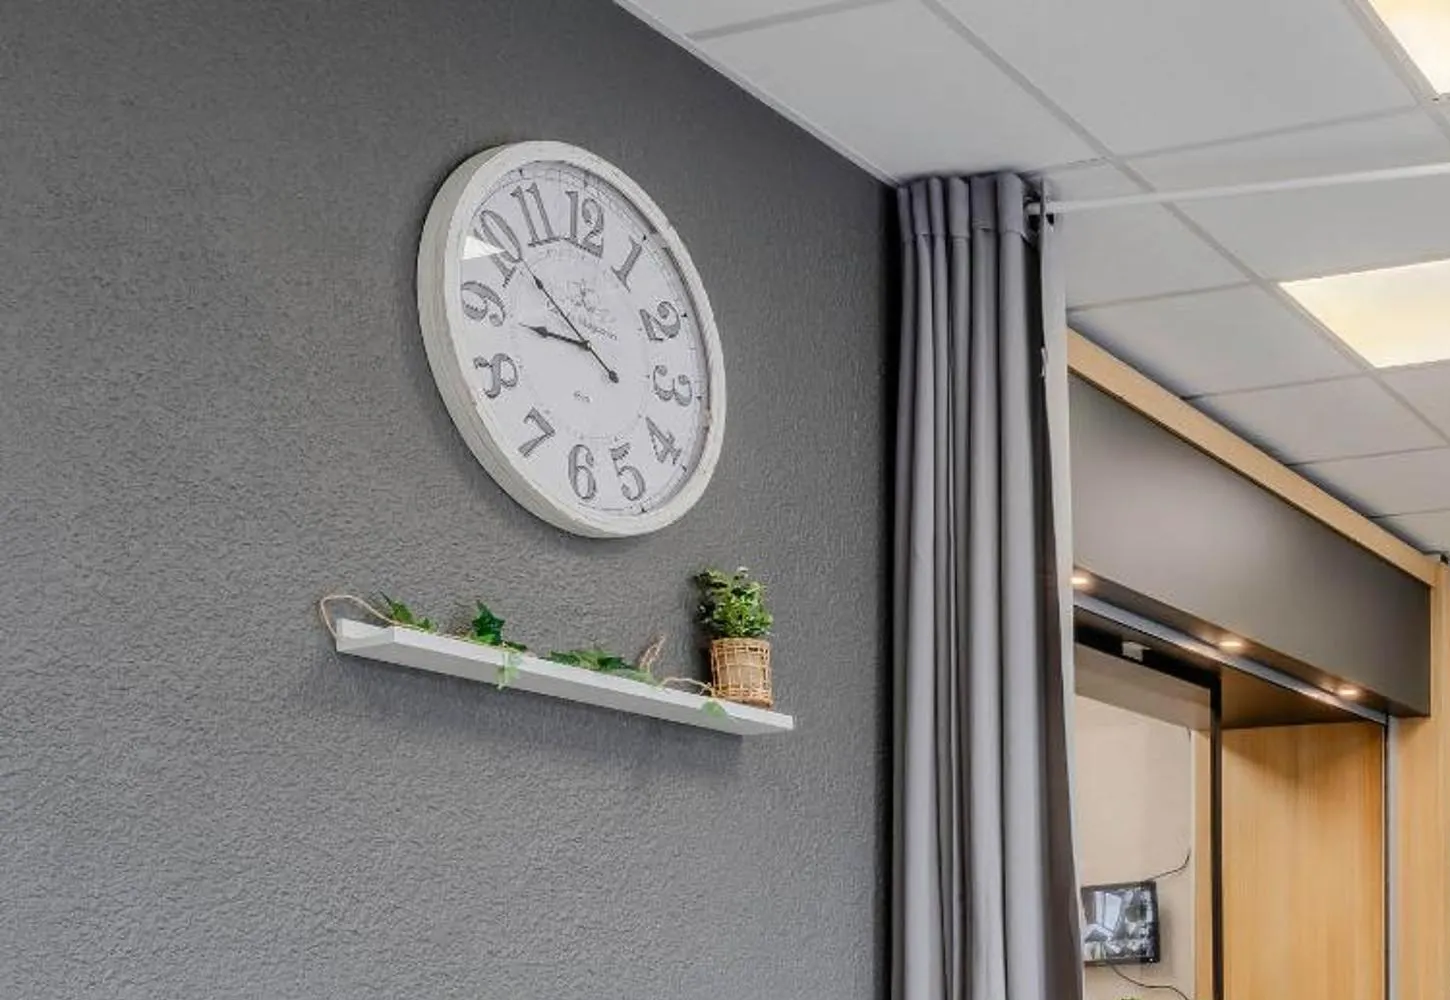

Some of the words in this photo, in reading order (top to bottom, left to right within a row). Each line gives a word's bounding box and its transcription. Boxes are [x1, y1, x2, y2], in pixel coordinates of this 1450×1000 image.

[510, 182, 561, 248] 11
[564, 190, 605, 259] 12
[473, 210, 524, 288] 10
[610, 234, 643, 293] 1
[461, 280, 506, 327] 9
[639, 301, 683, 342] 2
[473, 353, 519, 399] 8
[652, 364, 693, 407] 3
[517, 407, 556, 459] 7
[645, 416, 684, 466] 4
[568, 444, 598, 501] 6
[609, 441, 646, 502] 5
